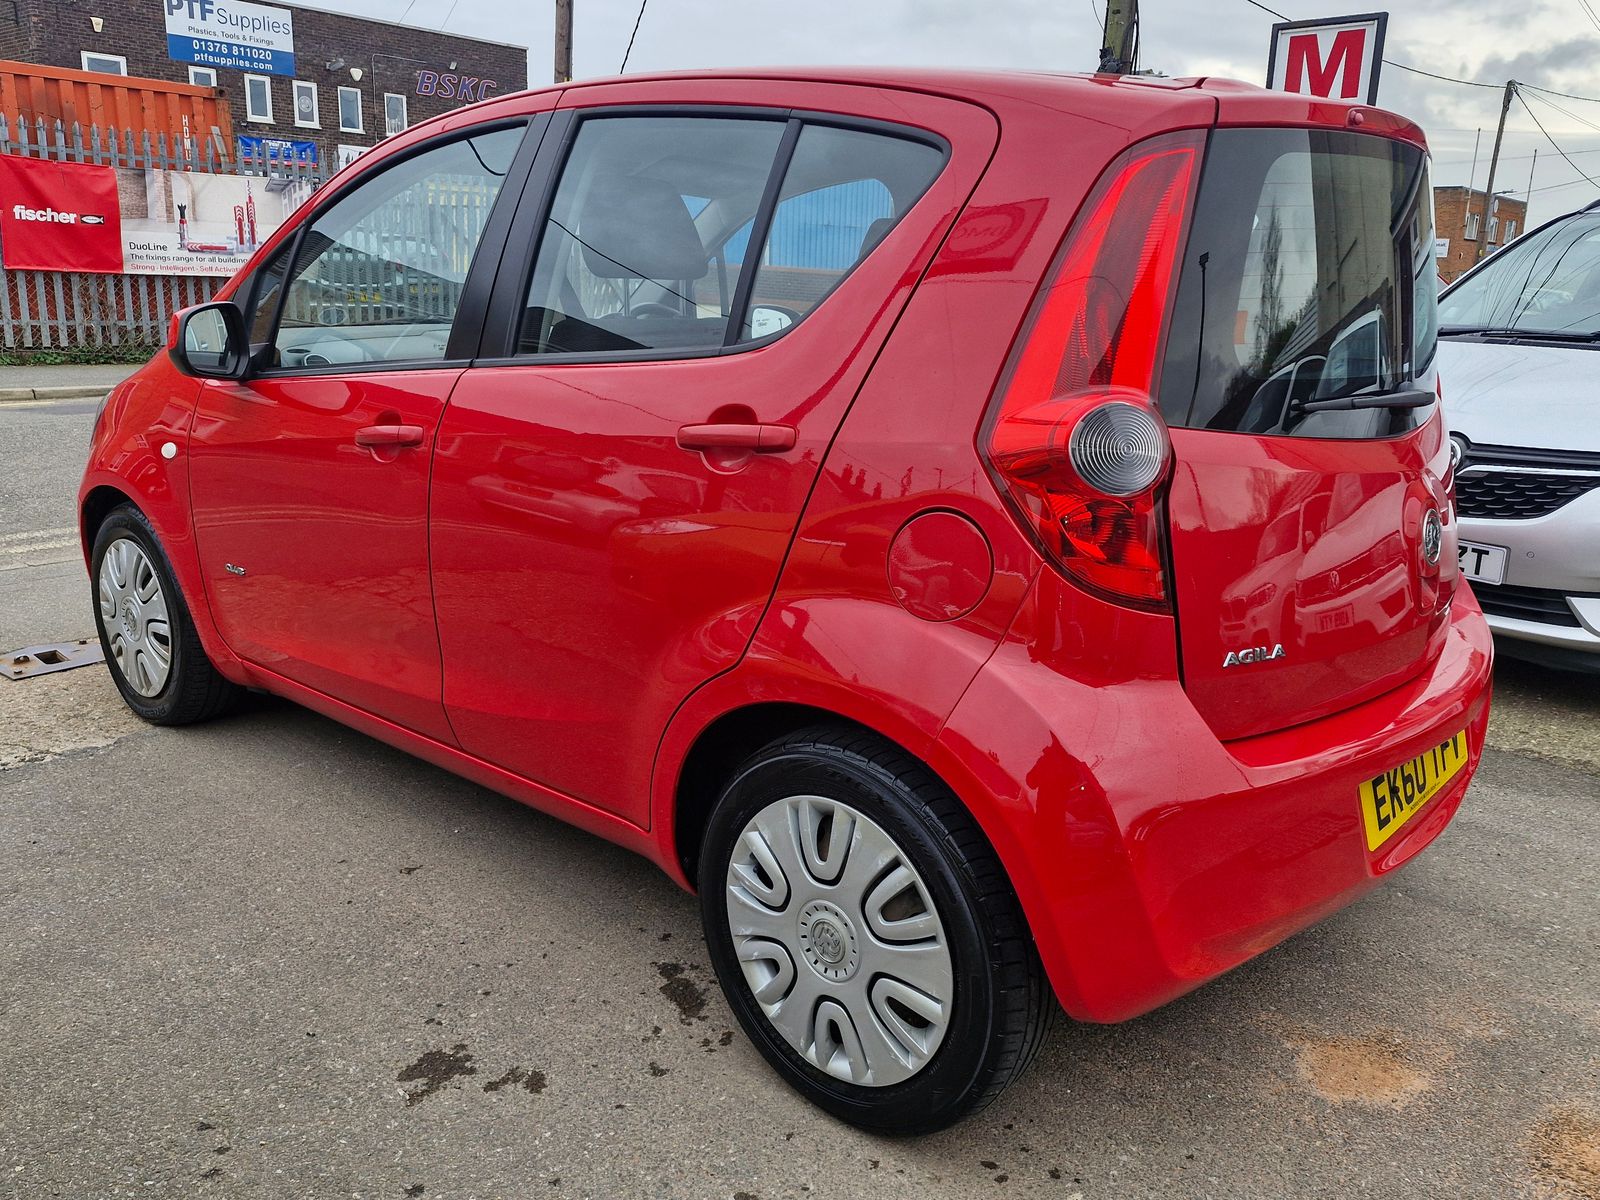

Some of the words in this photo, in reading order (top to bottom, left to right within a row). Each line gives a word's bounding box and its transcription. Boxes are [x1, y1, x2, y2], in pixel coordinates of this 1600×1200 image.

[167, 0, 214, 21] PTF
[216, 8, 291, 36] Supplies
[188, 25, 219, 37] Plastics,
[221, 31, 240, 41] Tools
[249, 35, 275, 46] Fixings
[192, 39, 228, 54] 01376
[232, 45, 272, 61] 811020
[194, 52, 273, 71] ptfsupplies.com
[1284, 29, 1366, 99] M
[416, 70, 497, 102] BSKC
[13, 204, 77, 224] fischer
[129, 241, 168, 252] DuoLine
[130, 253, 145, 261] The
[145, 253, 171, 262] fixings
[130, 263, 155, 271] Strong
[159, 264, 196, 272] Intelligent
[199, 265, 214, 273] Self
[1222, 643, 1286, 668] AGILA
